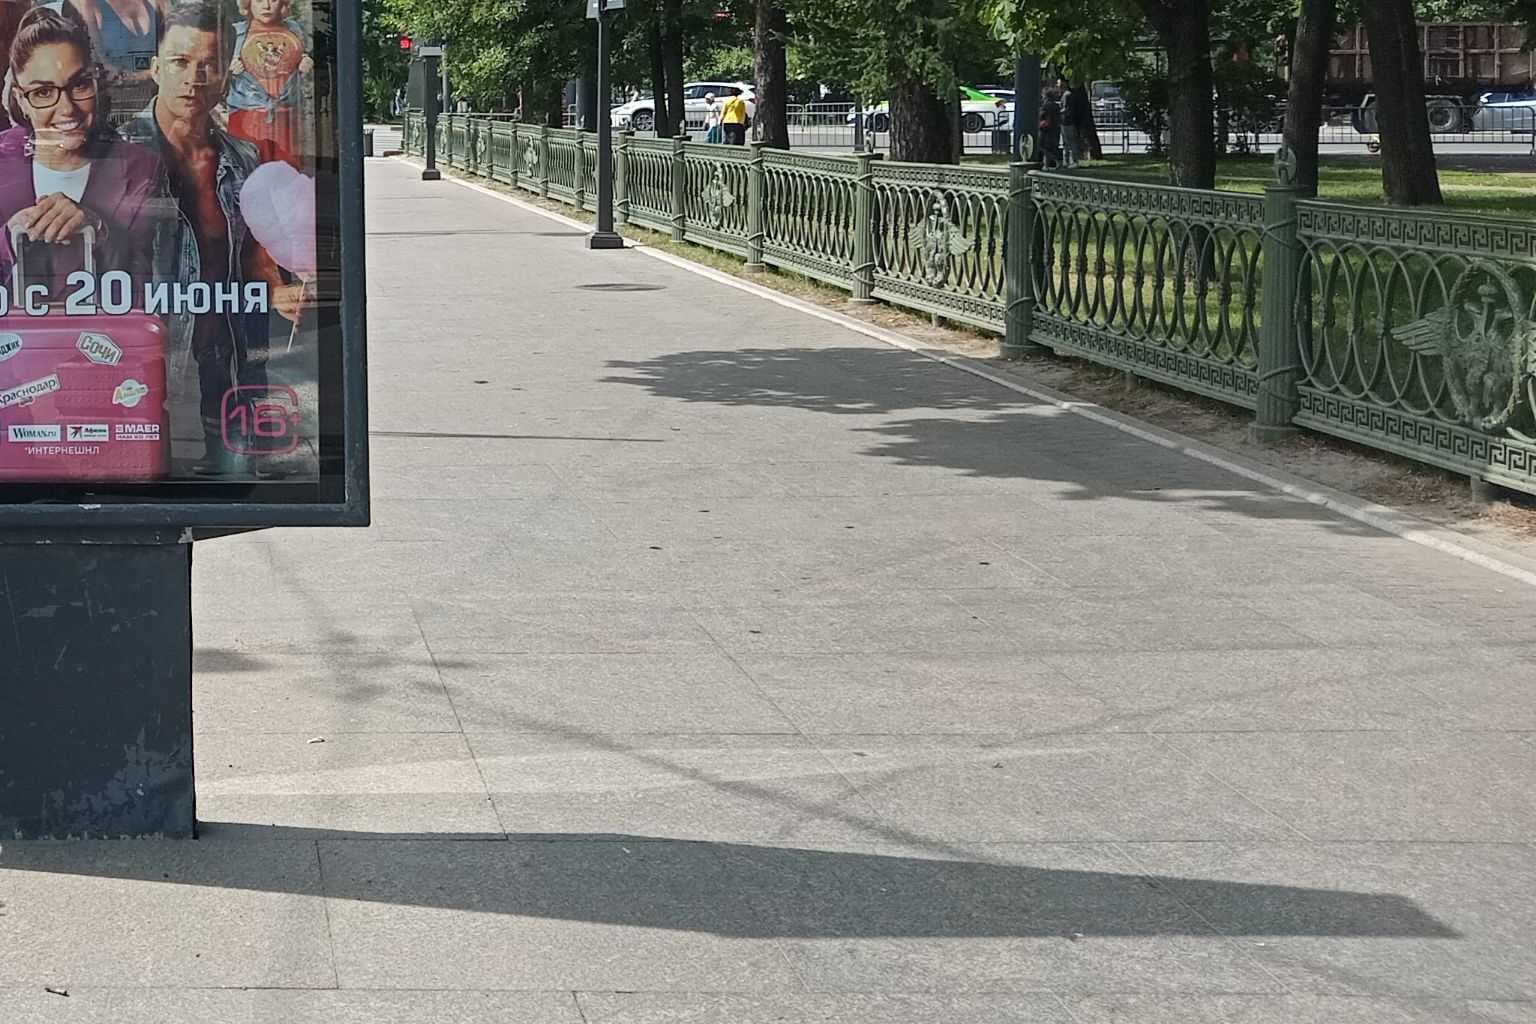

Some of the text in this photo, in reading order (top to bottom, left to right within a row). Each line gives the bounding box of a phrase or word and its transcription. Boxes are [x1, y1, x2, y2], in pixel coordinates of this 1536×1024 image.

[24, 285, 49, 316] С
[65, 270, 134, 315] 20
[144, 282, 268, 314] ИЮНЯ
[124, 424, 160, 433] MAER
[229, 404, 302, 437] 16+
